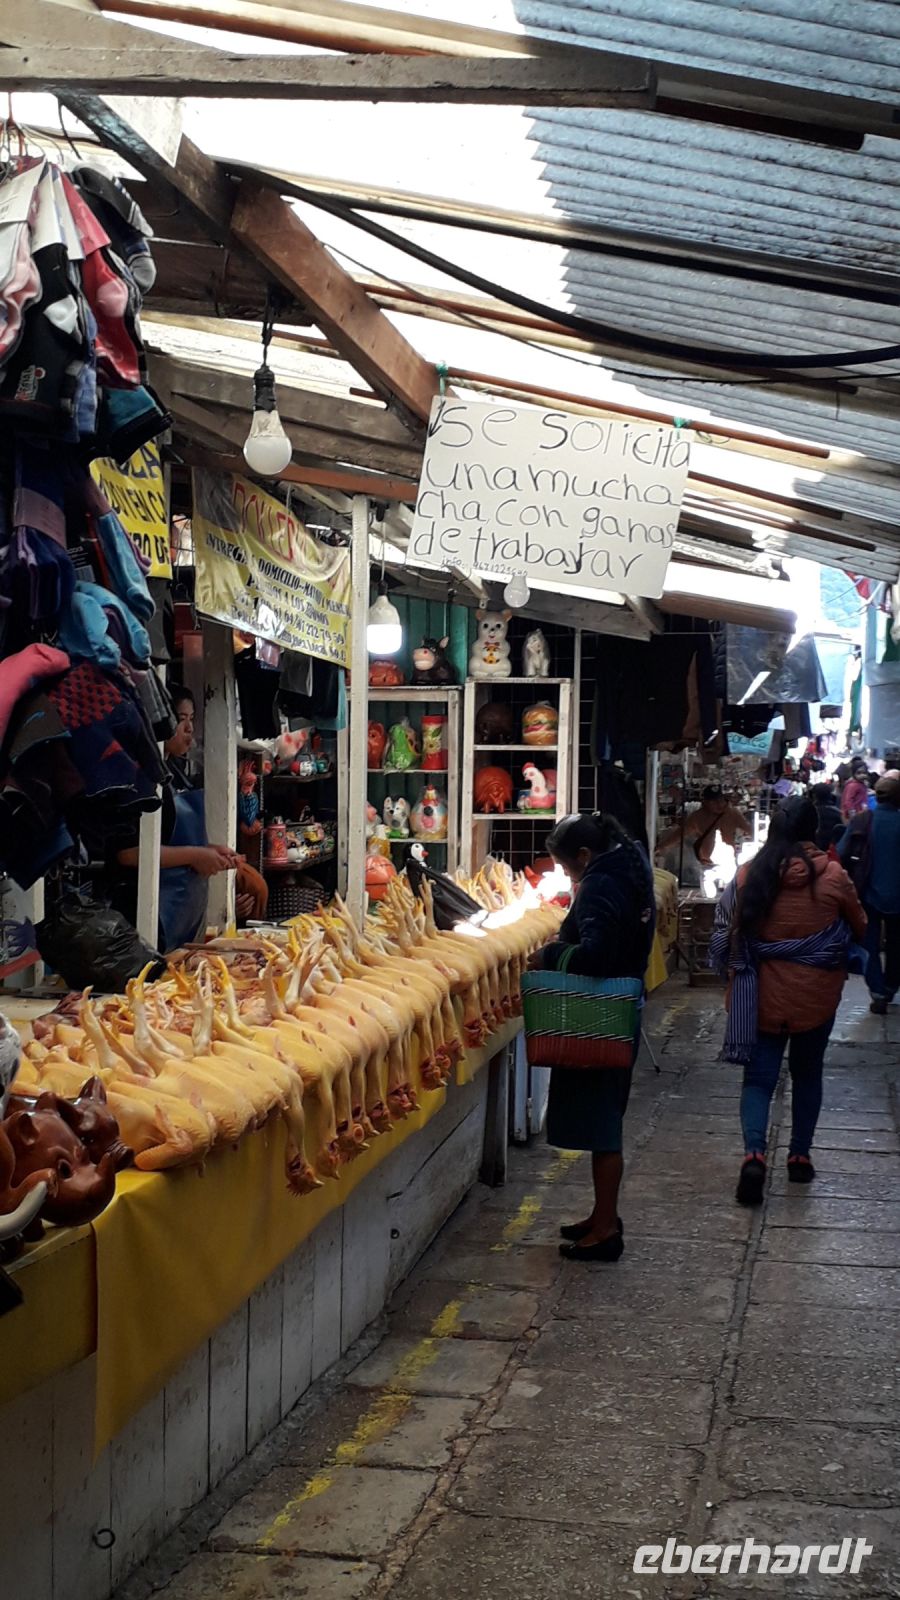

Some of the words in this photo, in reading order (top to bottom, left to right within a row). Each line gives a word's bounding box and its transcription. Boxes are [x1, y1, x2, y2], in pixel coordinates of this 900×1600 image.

[528, 463, 683, 506] mucha
[414, 520, 462, 555] de
[579, 506, 676, 549] ganas
